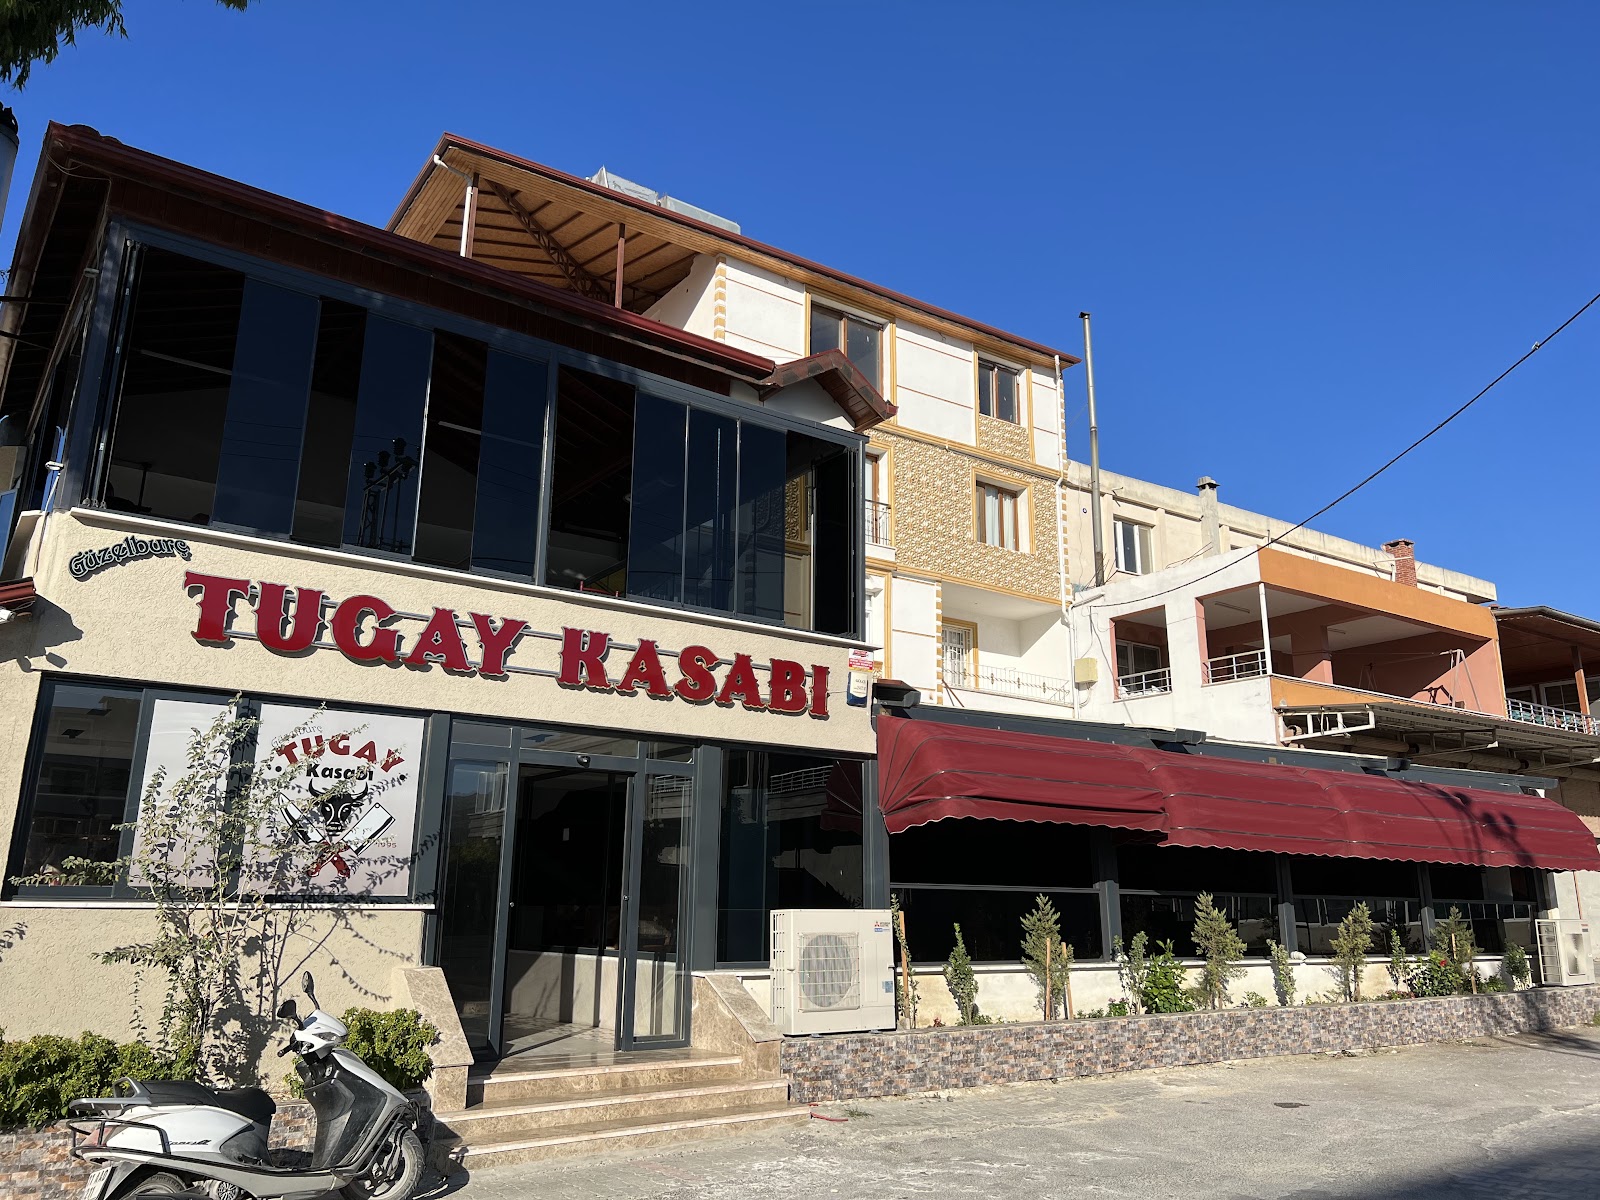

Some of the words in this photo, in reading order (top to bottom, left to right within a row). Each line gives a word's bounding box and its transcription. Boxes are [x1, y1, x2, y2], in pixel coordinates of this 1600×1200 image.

[182, 570, 529, 676] TUGAY
[556, 626, 830, 717] KASABI
[276, 734, 405, 773] TUGAY
